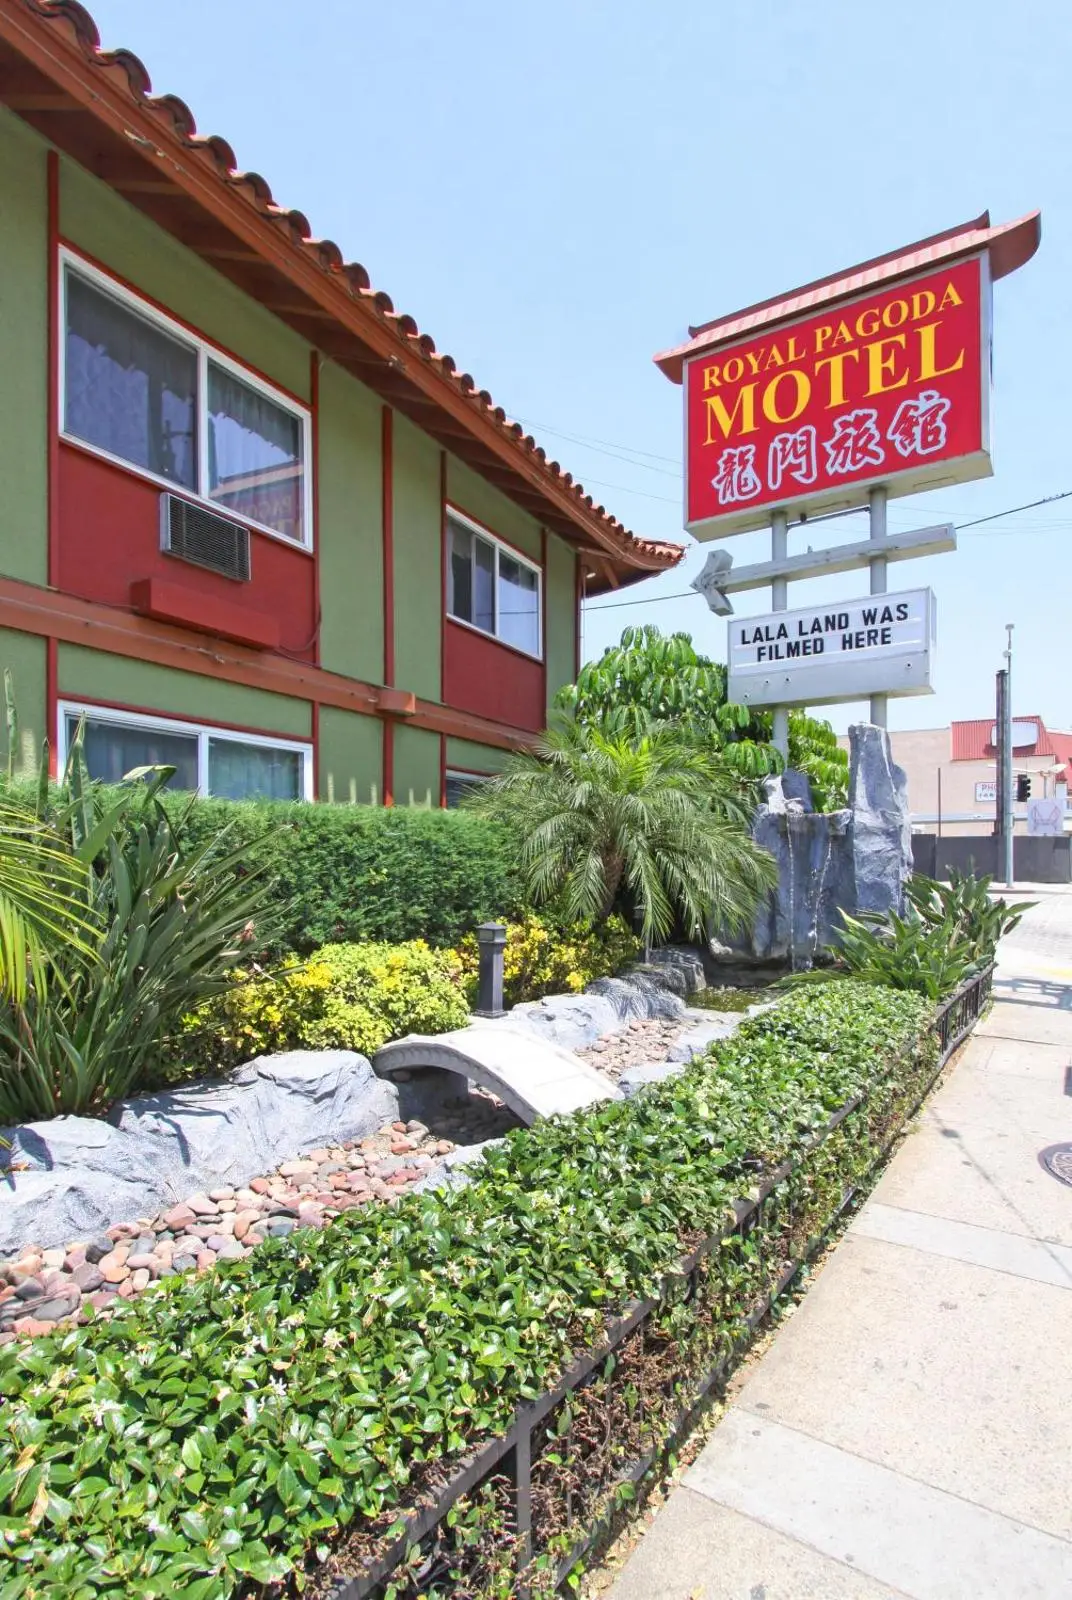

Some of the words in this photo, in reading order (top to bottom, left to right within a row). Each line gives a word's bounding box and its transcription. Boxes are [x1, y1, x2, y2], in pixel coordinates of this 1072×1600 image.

[702, 337, 807, 392] ROYAL
[814, 282, 964, 353] PAGODA
[702, 321, 965, 446] MOTEL
[711, 389, 951, 505] 龍門旅館
[741, 622, 789, 645] LALA
[798, 612, 850, 637] LAND
[861, 603, 909, 627] WAS
[757, 637, 825, 662] FILMED
[841, 627, 892, 651] HERE
